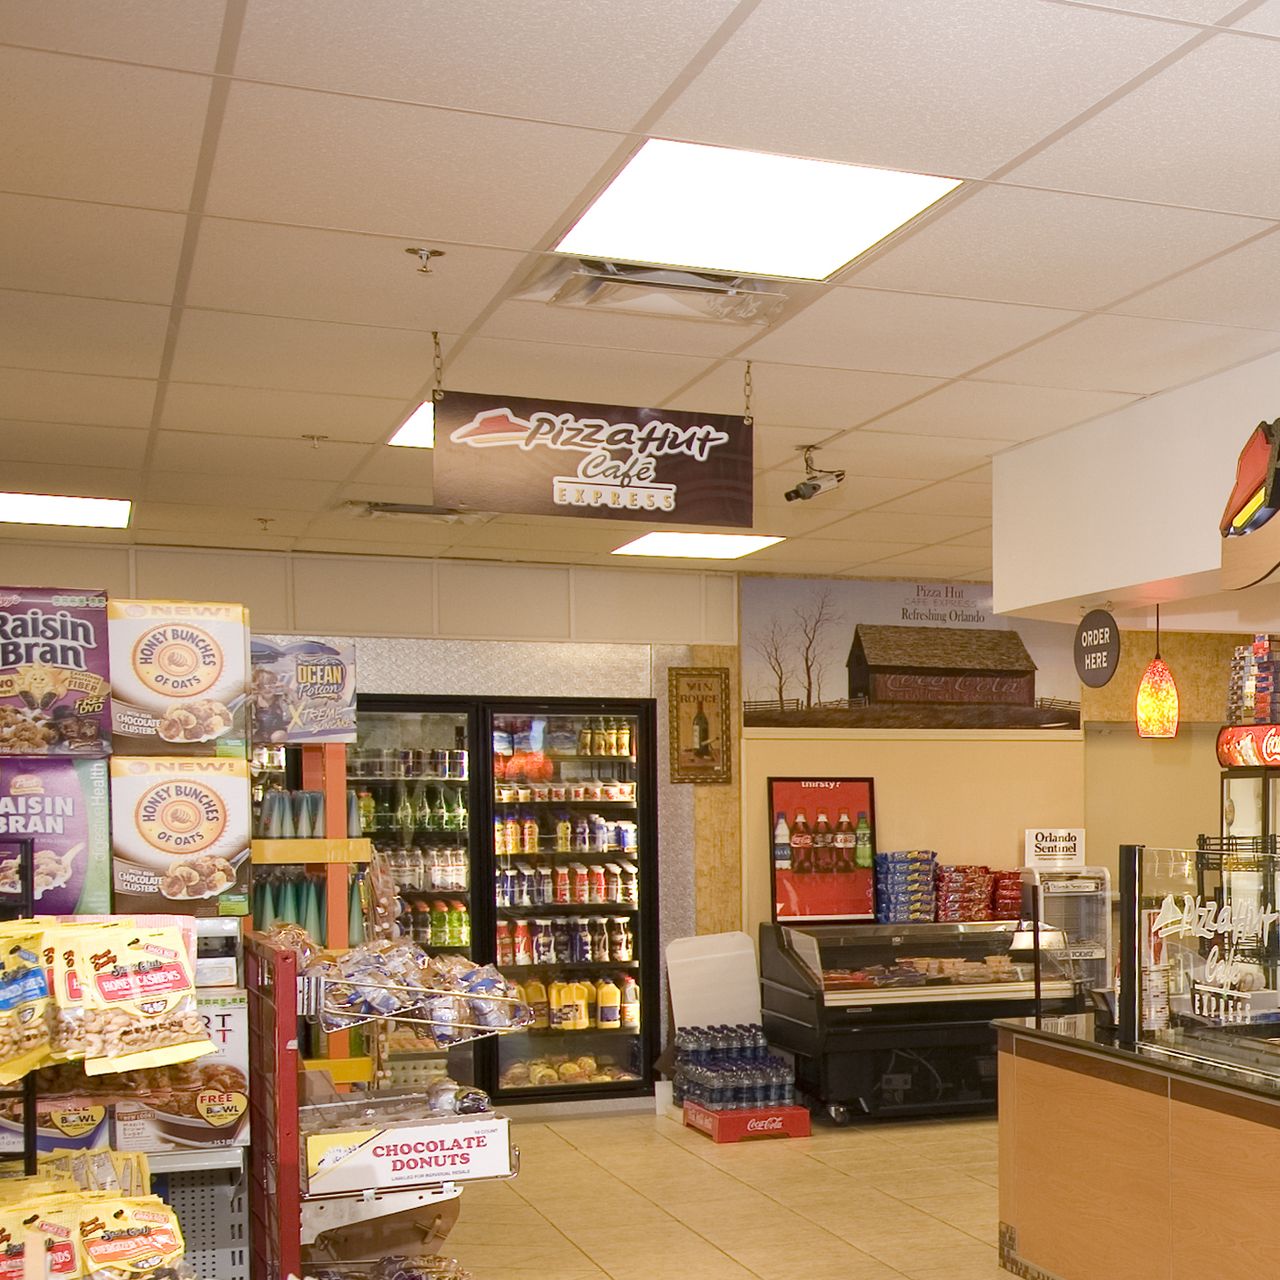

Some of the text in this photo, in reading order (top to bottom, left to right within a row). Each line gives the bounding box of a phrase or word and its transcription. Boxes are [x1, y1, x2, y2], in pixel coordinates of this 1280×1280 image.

[525, 417, 723, 457] Pizza Hut
[582, 454, 653, 488] Café
[558, 487, 673, 509] EXPRESS
[916, 585, 964, 598] Pizza Hut
[933, 599, 977, 608] EXPRESS
[152, 607, 231, 617] NEW!
[902, 608, 985, 623] Refreshing Orlando
[1082, 628, 1110, 647] ORDER
[139, 628, 216, 667] HONEY BUNCHES
[1, 641, 86, 669] Bran
[1085, 651, 1107, 670] HERE
[297, 665, 342, 684] OCEAN
[67, 680, 98, 694] FIBER
[154, 675, 201, 689] OF OATS
[687, 682, 714, 691] VIN
[679, 693, 719, 704] ROUGE
[117, 714, 161, 728] CHOCOLATE
[121, 723, 158, 735] CLUSTERS
[154, 762, 235, 772] NEW!
[142, 785, 219, 823] HONEY BUNCHES
[157, 832, 204, 846] OF OATS
[1035, 832, 1077, 842] Orlando
[1034, 843, 1077, 853] Sentinel
[118, 872, 163, 885] CHOCOLATE
[123, 881, 159, 893] CLUSTERS
[1180, 895, 1232, 939] Pizza
[102, 971, 181, 992] HONEY CASHEWS
[200, 1093, 233, 1104] FREE
[372, 1136, 488, 1158] CHOCOLATE
[391, 1153, 471, 1172] DONUTS
